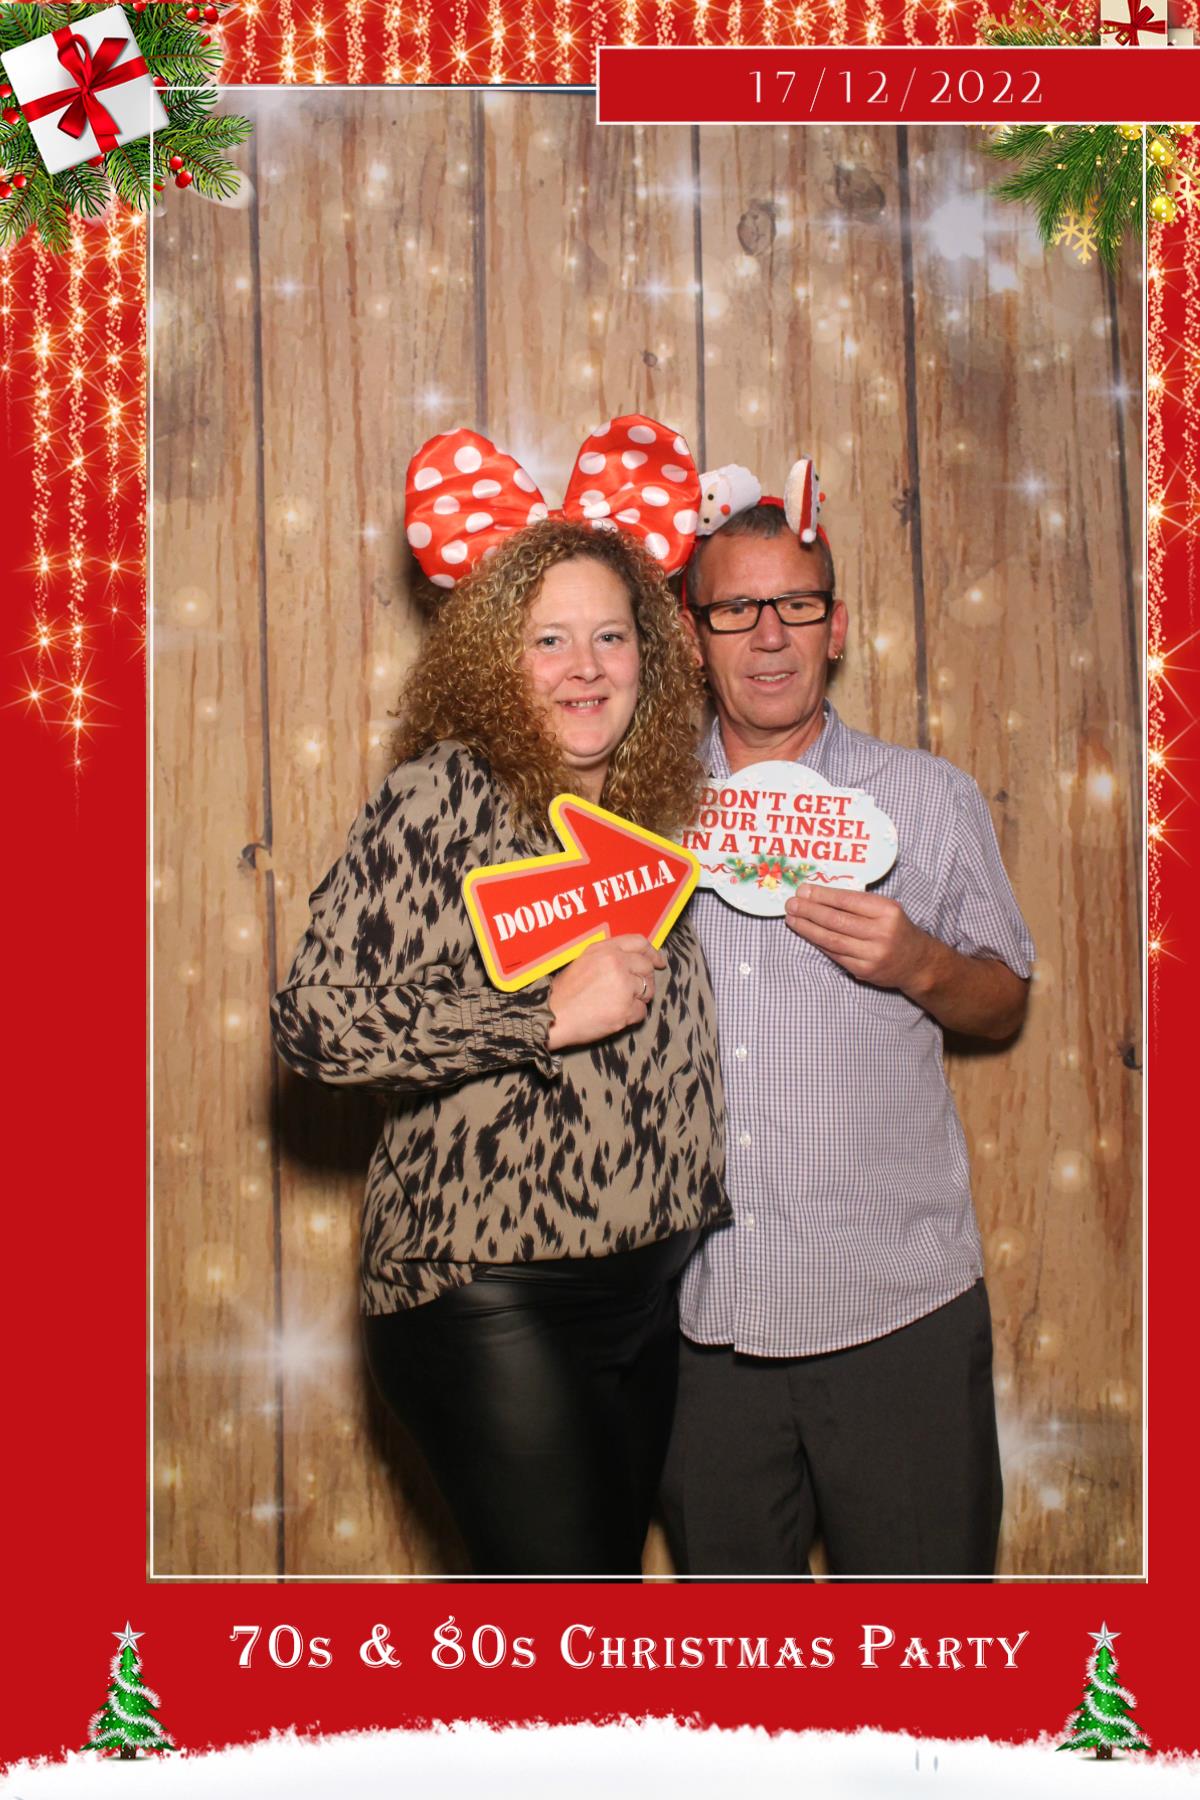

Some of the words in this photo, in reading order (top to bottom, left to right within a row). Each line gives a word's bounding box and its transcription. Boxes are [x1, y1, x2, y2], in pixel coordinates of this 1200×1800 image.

[700, 787, 786, 812] DON'T
[792, 793, 852, 817] GET
[765, 813, 871, 841] TINSEL
[681, 830, 712, 851] IN
[718, 833, 740, 853] A
[748, 836, 867, 864] TANGLE
[492, 886, 588, 942] DODGY
[591, 859, 676, 908] FELLA
